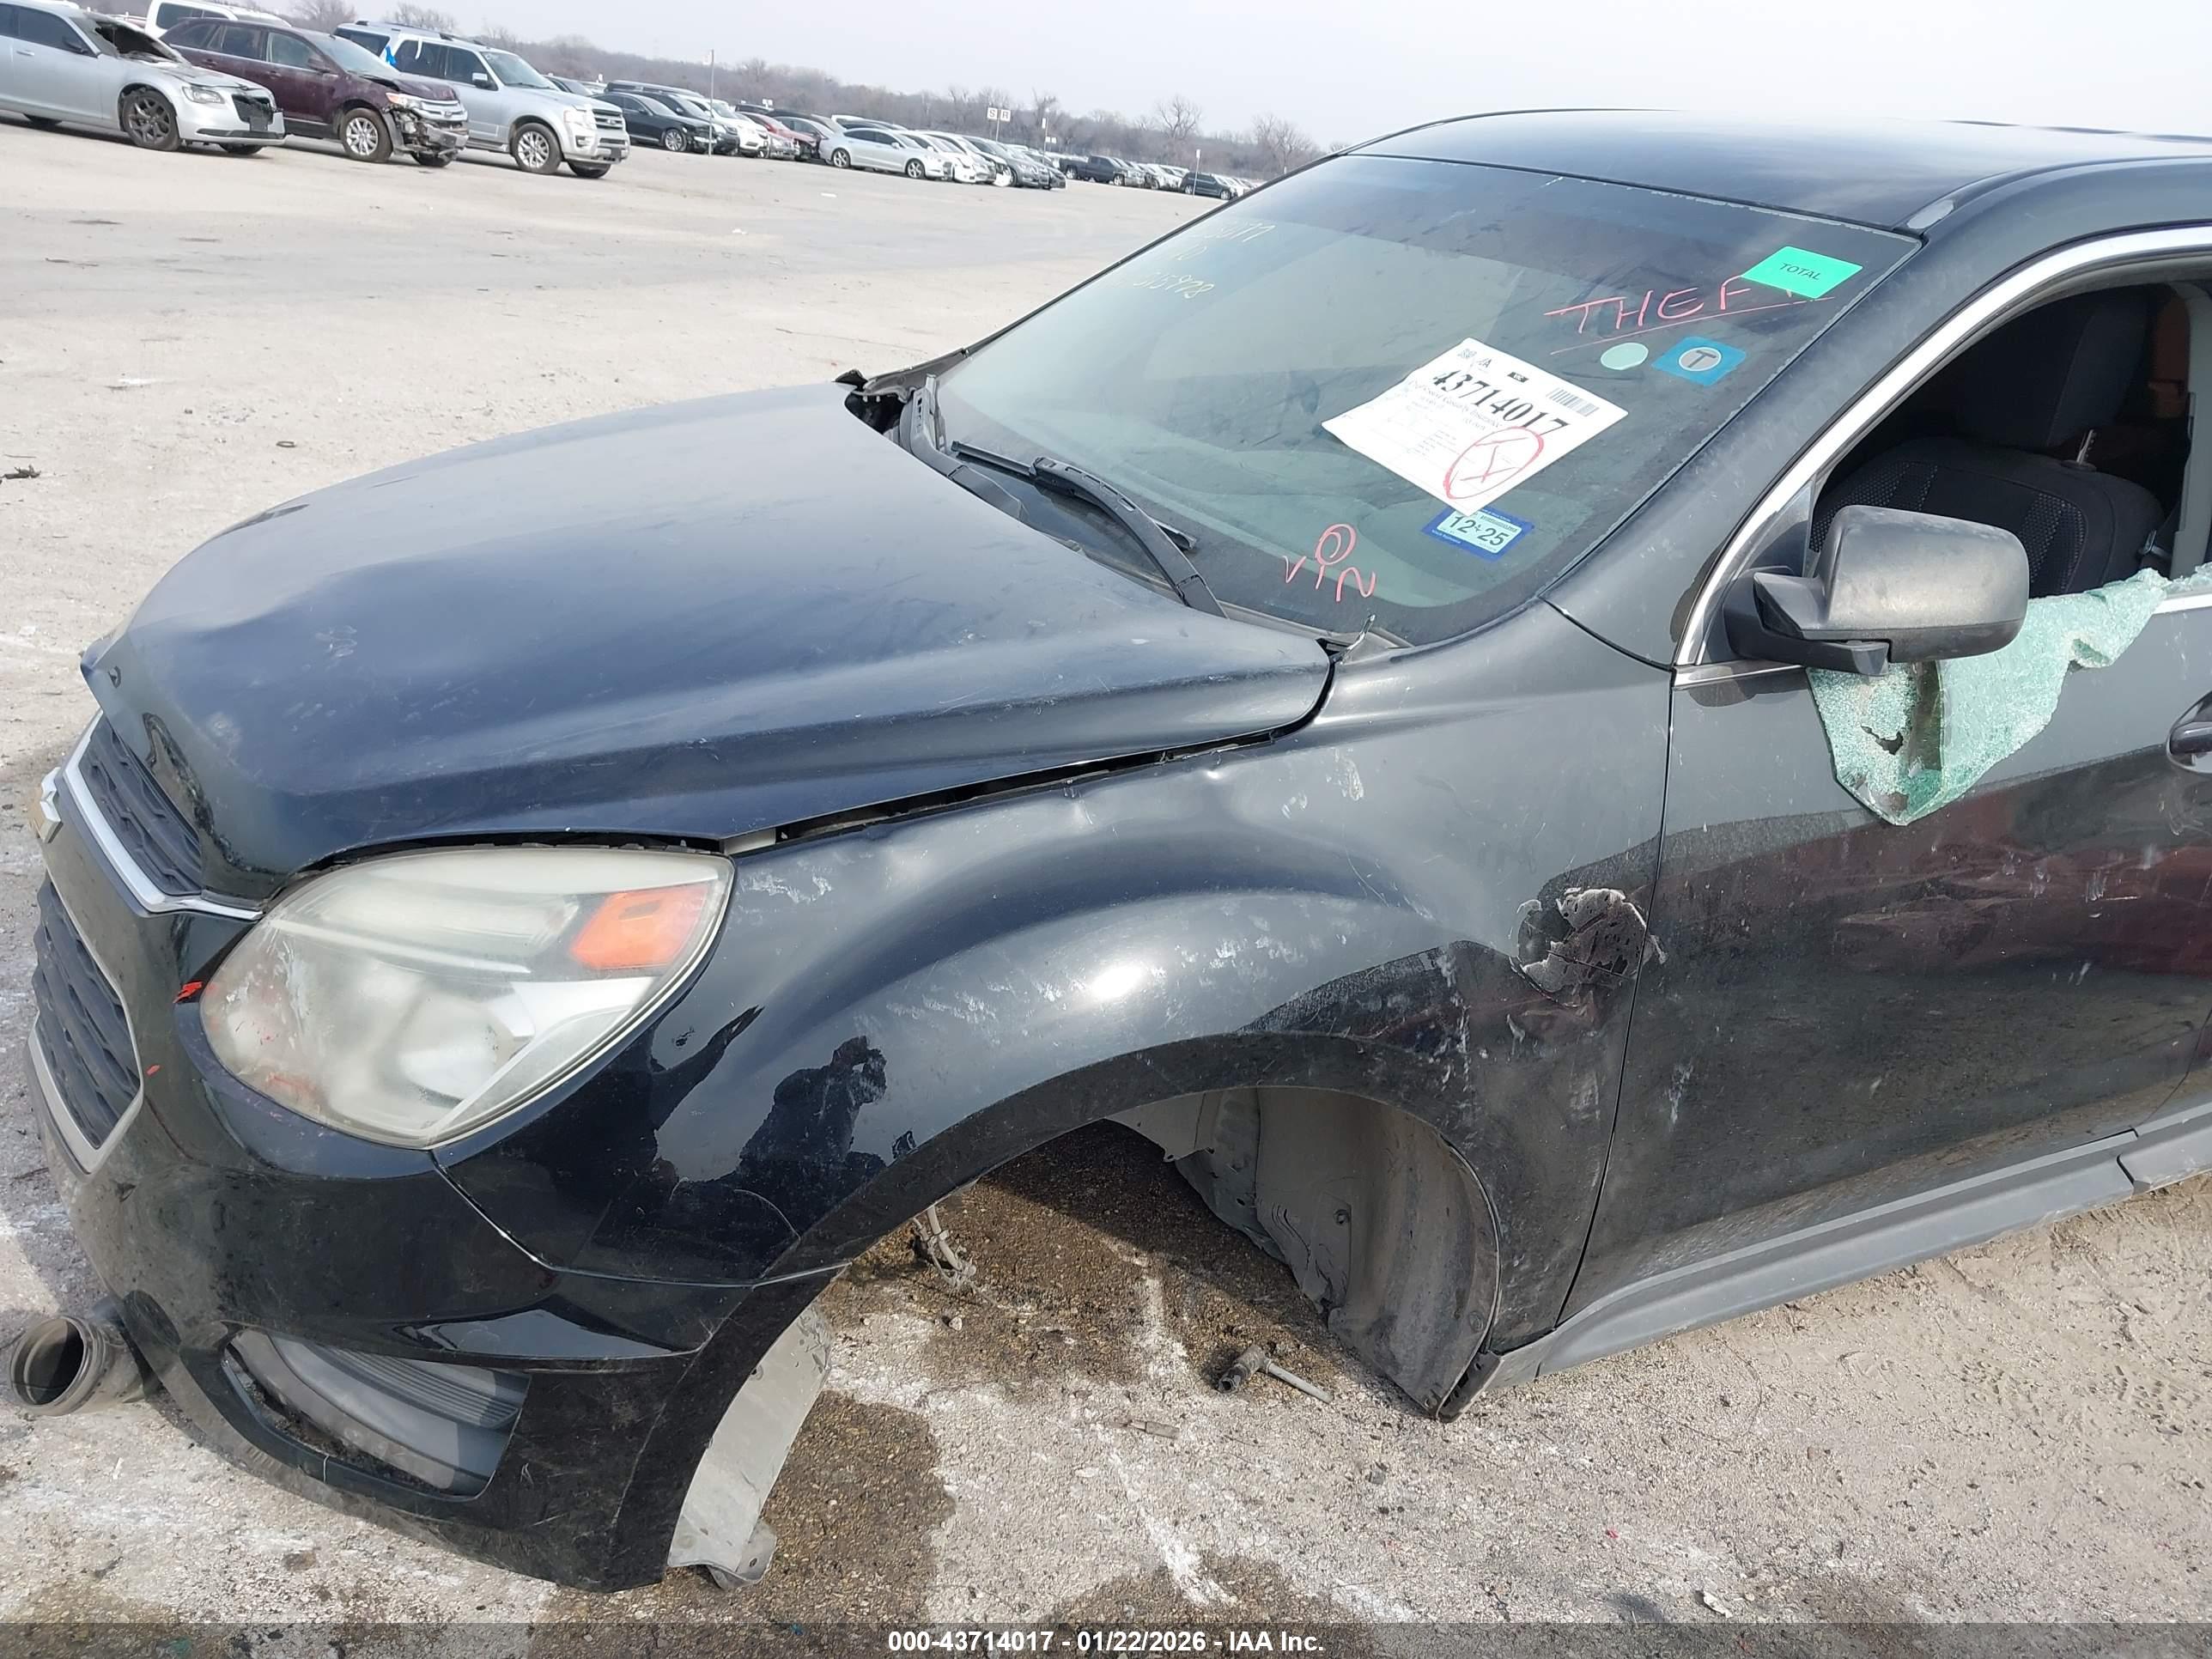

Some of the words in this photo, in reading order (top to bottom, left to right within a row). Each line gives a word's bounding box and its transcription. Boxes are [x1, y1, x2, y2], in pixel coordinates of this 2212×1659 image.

[1778, 262, 1820, 281] TOTAL
[1543, 275, 1793, 334] THEF
[1687, 349, 1717, 368] T
[1432, 369, 1571, 436] 43714017
[1449, 515, 1475, 534] 12
[1477, 528, 1510, 546] 25
